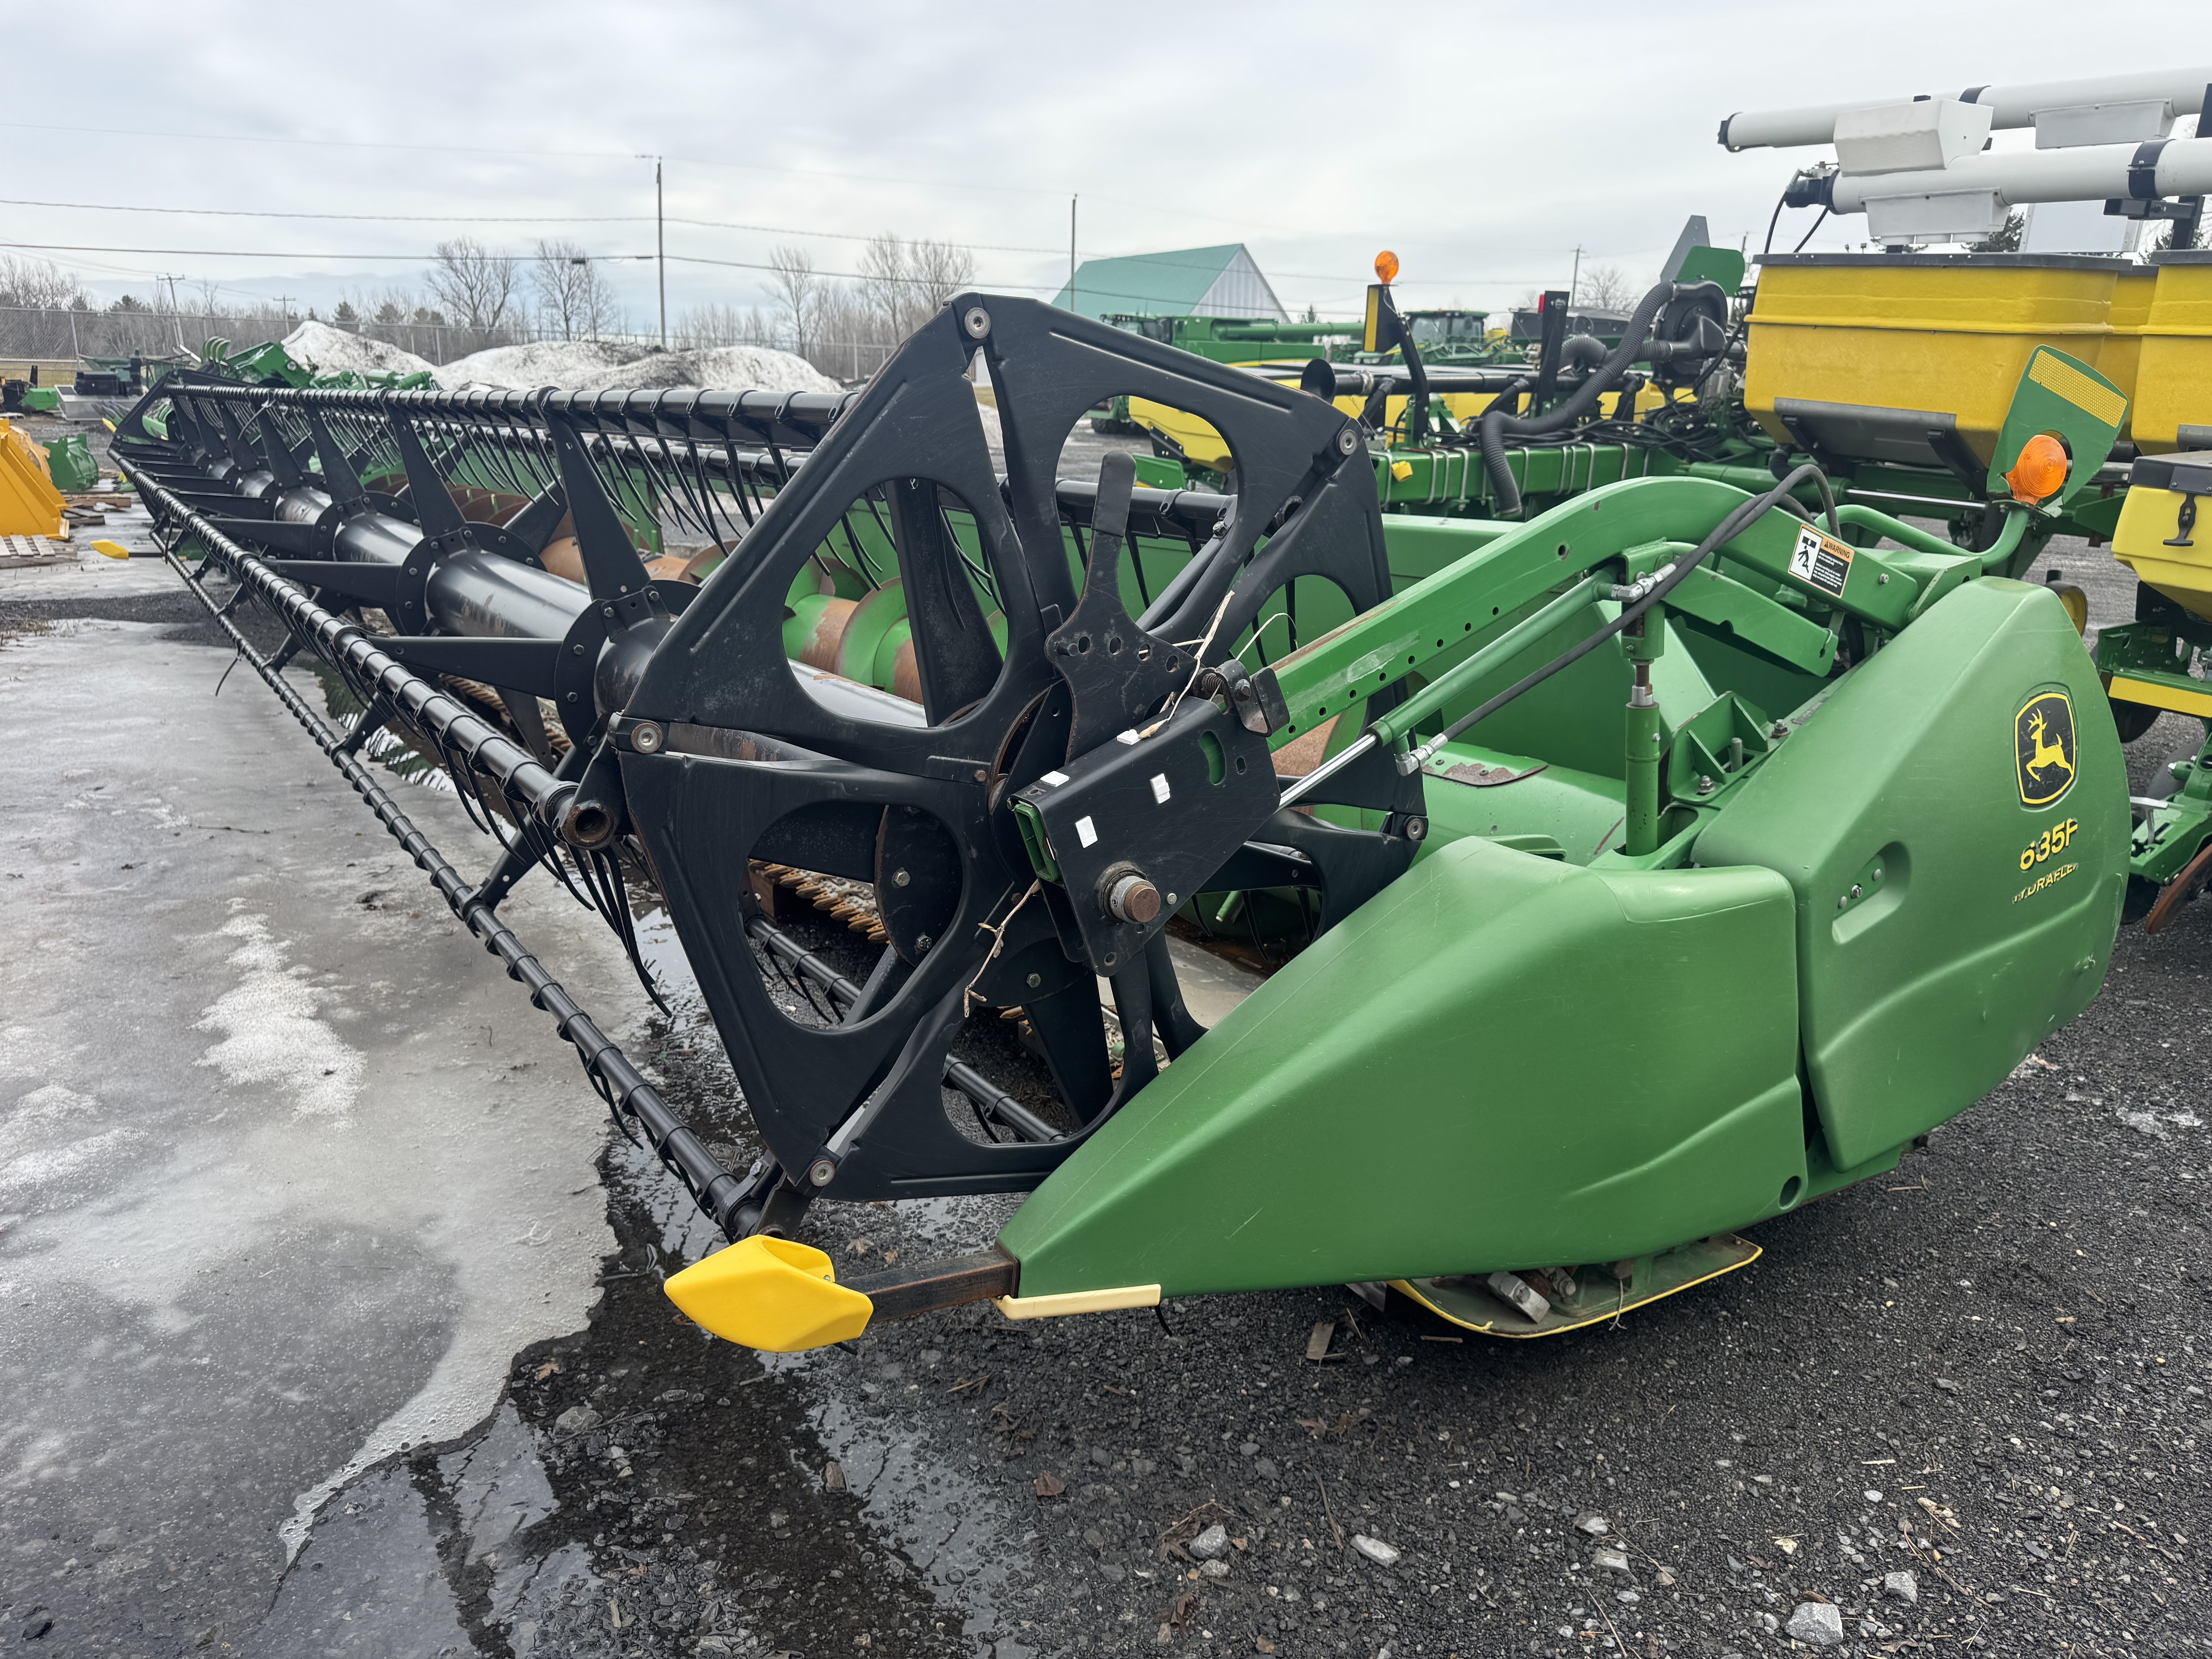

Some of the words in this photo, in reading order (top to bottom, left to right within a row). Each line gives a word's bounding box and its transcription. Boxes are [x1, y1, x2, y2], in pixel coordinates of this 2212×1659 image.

[1828, 542, 1850, 558] WARNING
[2020, 818, 2078, 870] 635F
[2014, 864, 2078, 903] YDRAFLE
